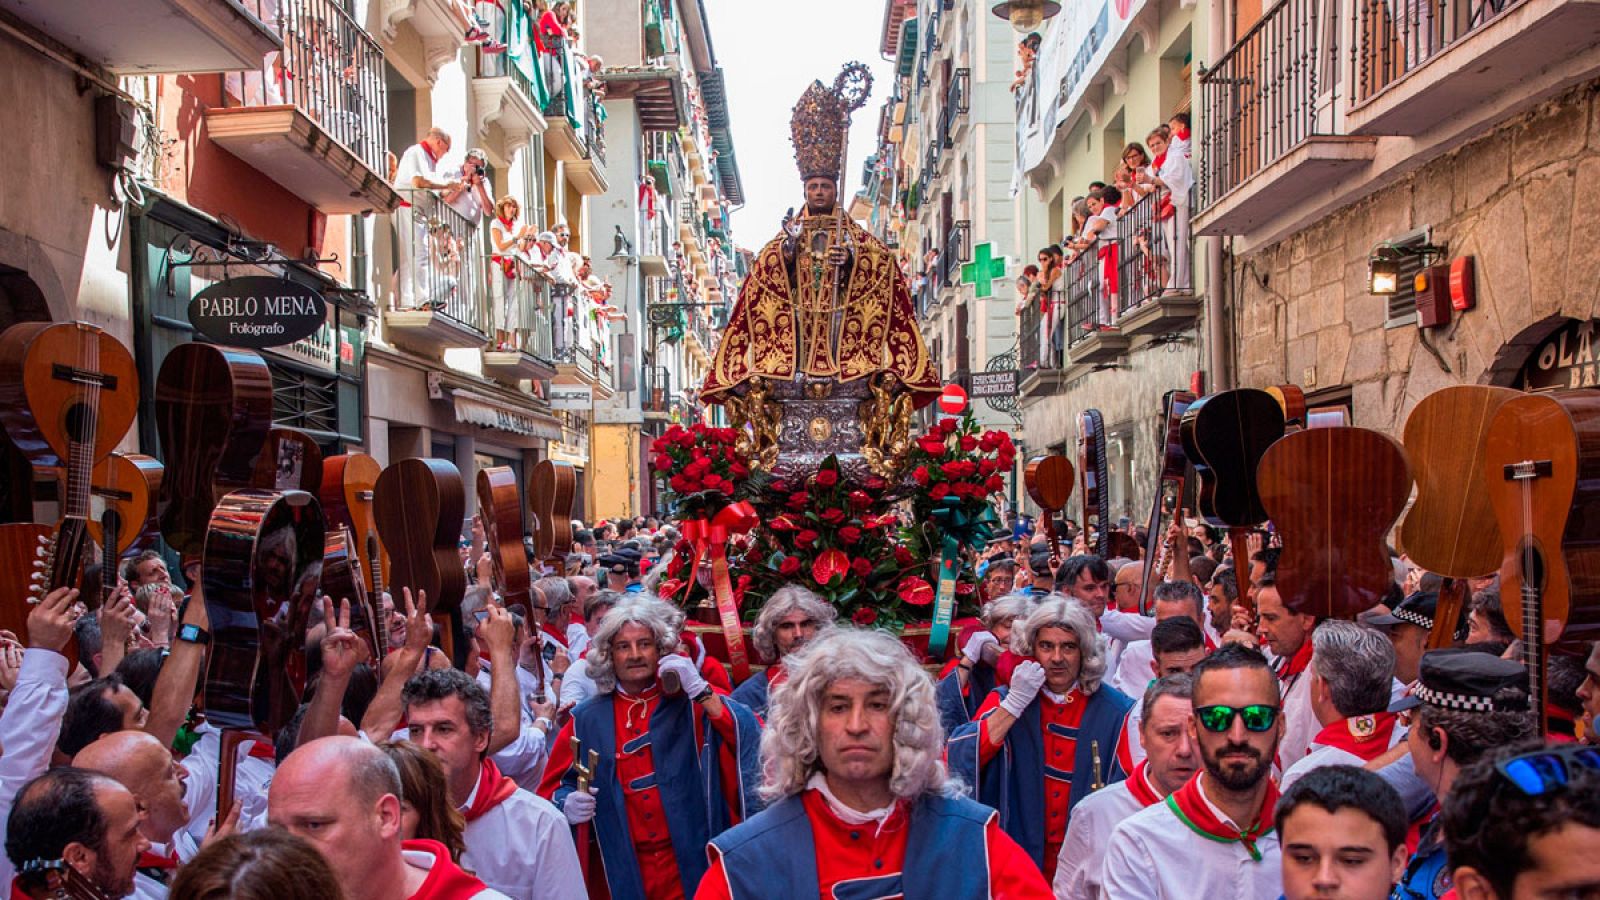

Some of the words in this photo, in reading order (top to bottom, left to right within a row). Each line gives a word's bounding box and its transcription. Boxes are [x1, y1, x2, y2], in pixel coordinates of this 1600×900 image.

[200, 296, 258, 317] PABLO
[264, 295, 318, 316] MENA
[229, 321, 285, 337] Fotógrafo
[1538, 320, 1600, 371] OLA
[1569, 364, 1600, 389] BA
